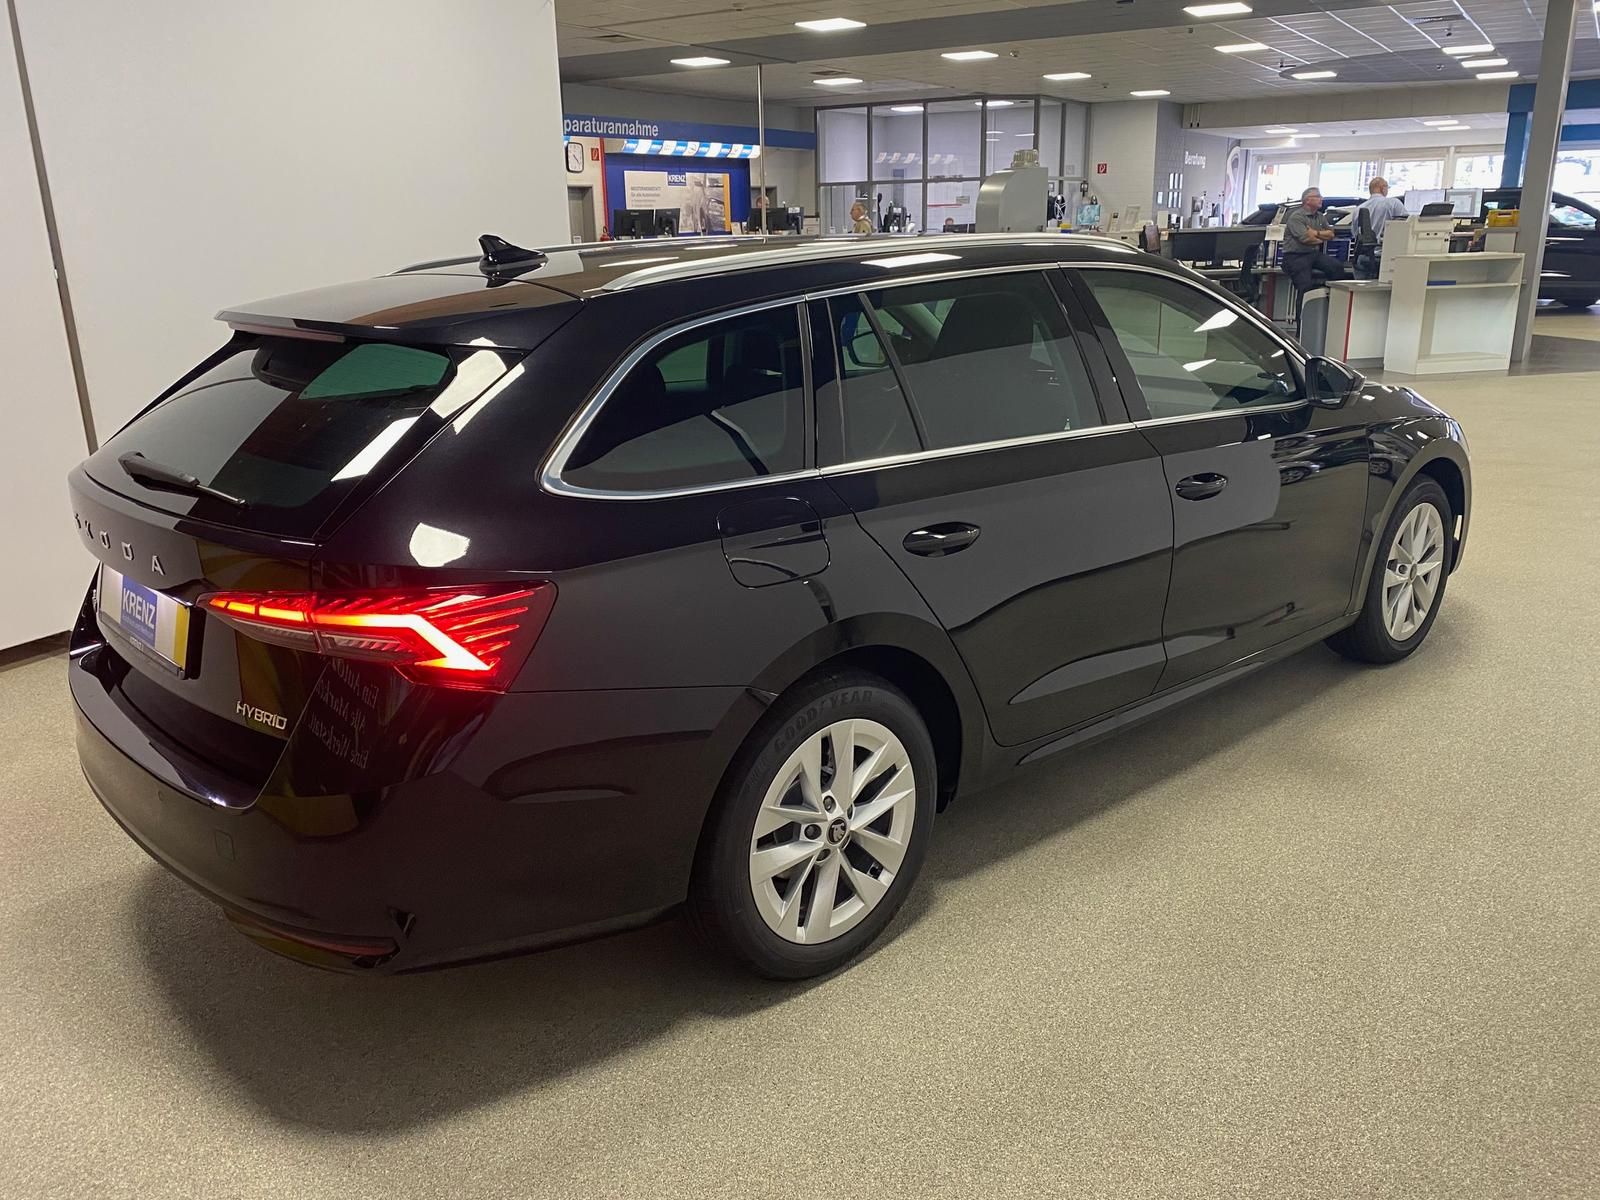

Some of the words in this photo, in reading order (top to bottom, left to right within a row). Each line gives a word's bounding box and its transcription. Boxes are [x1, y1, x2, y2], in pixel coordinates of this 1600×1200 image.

[563, 118, 659, 137] paraturannahme
[122, 587, 156, 629] KRENZ
[235, 700, 288, 731] HYBRID
